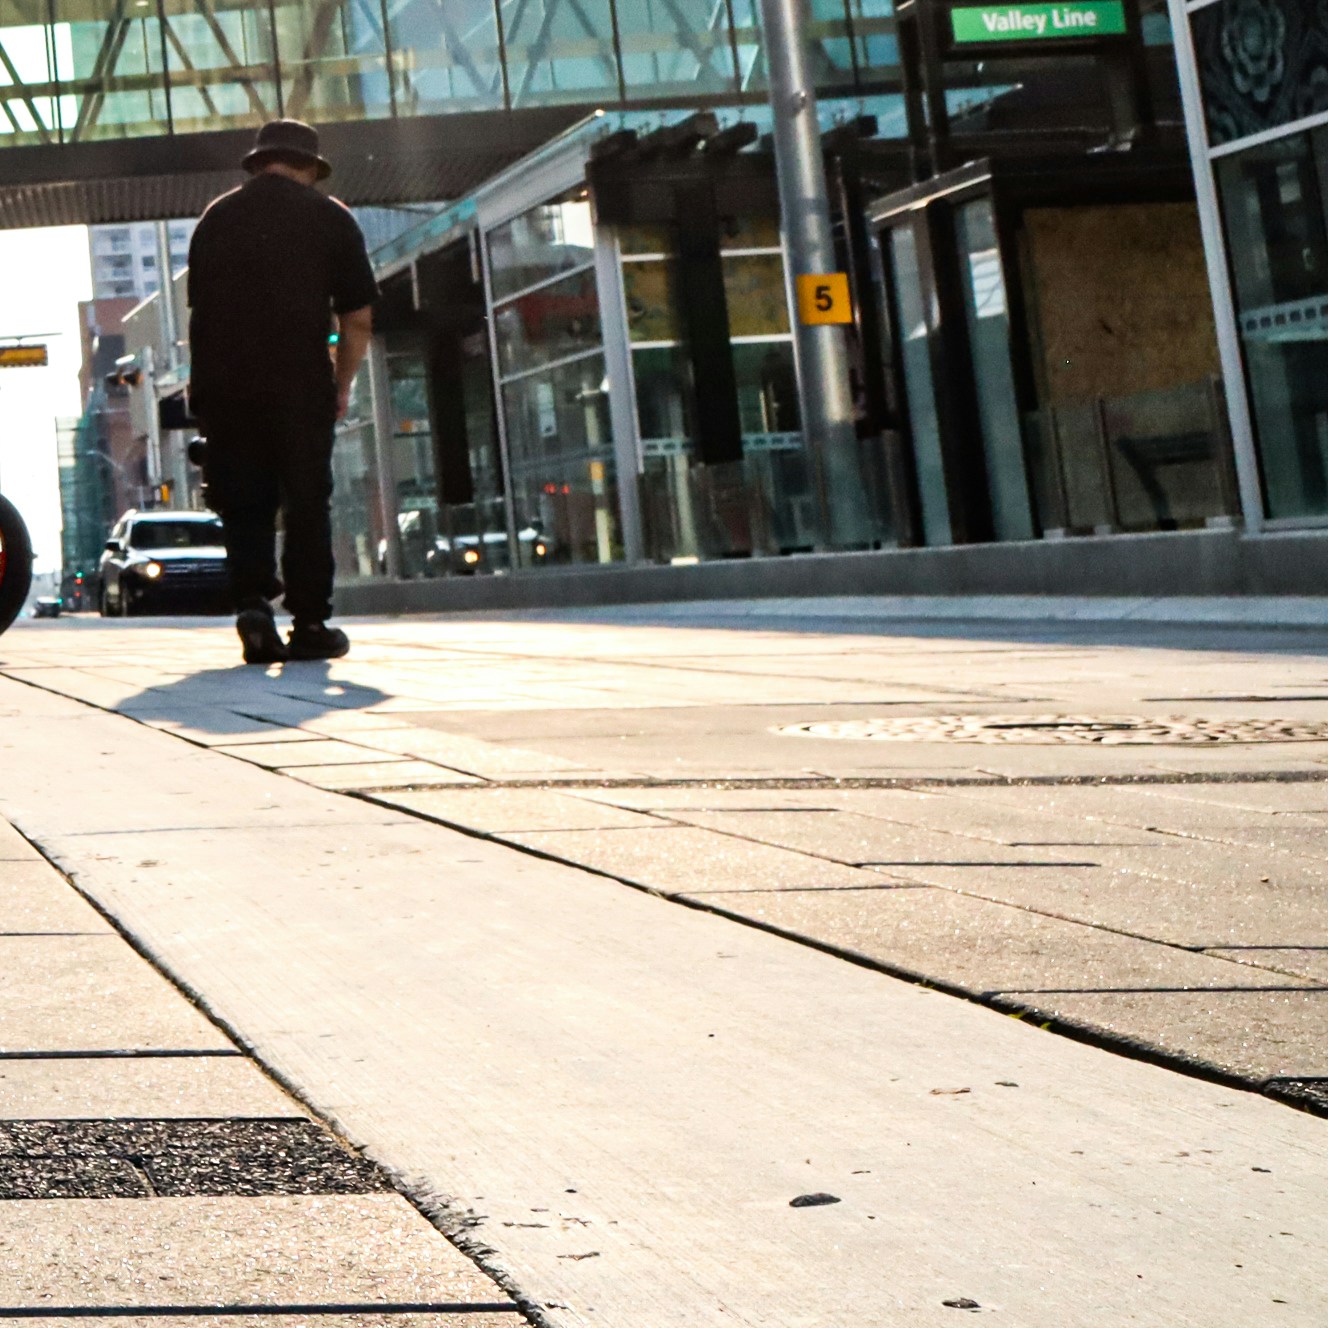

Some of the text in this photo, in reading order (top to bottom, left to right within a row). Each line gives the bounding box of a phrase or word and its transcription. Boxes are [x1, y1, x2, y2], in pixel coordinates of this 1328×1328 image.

[983, 7, 1097, 34] Valley Line
[815, 285, 833, 312] 5
